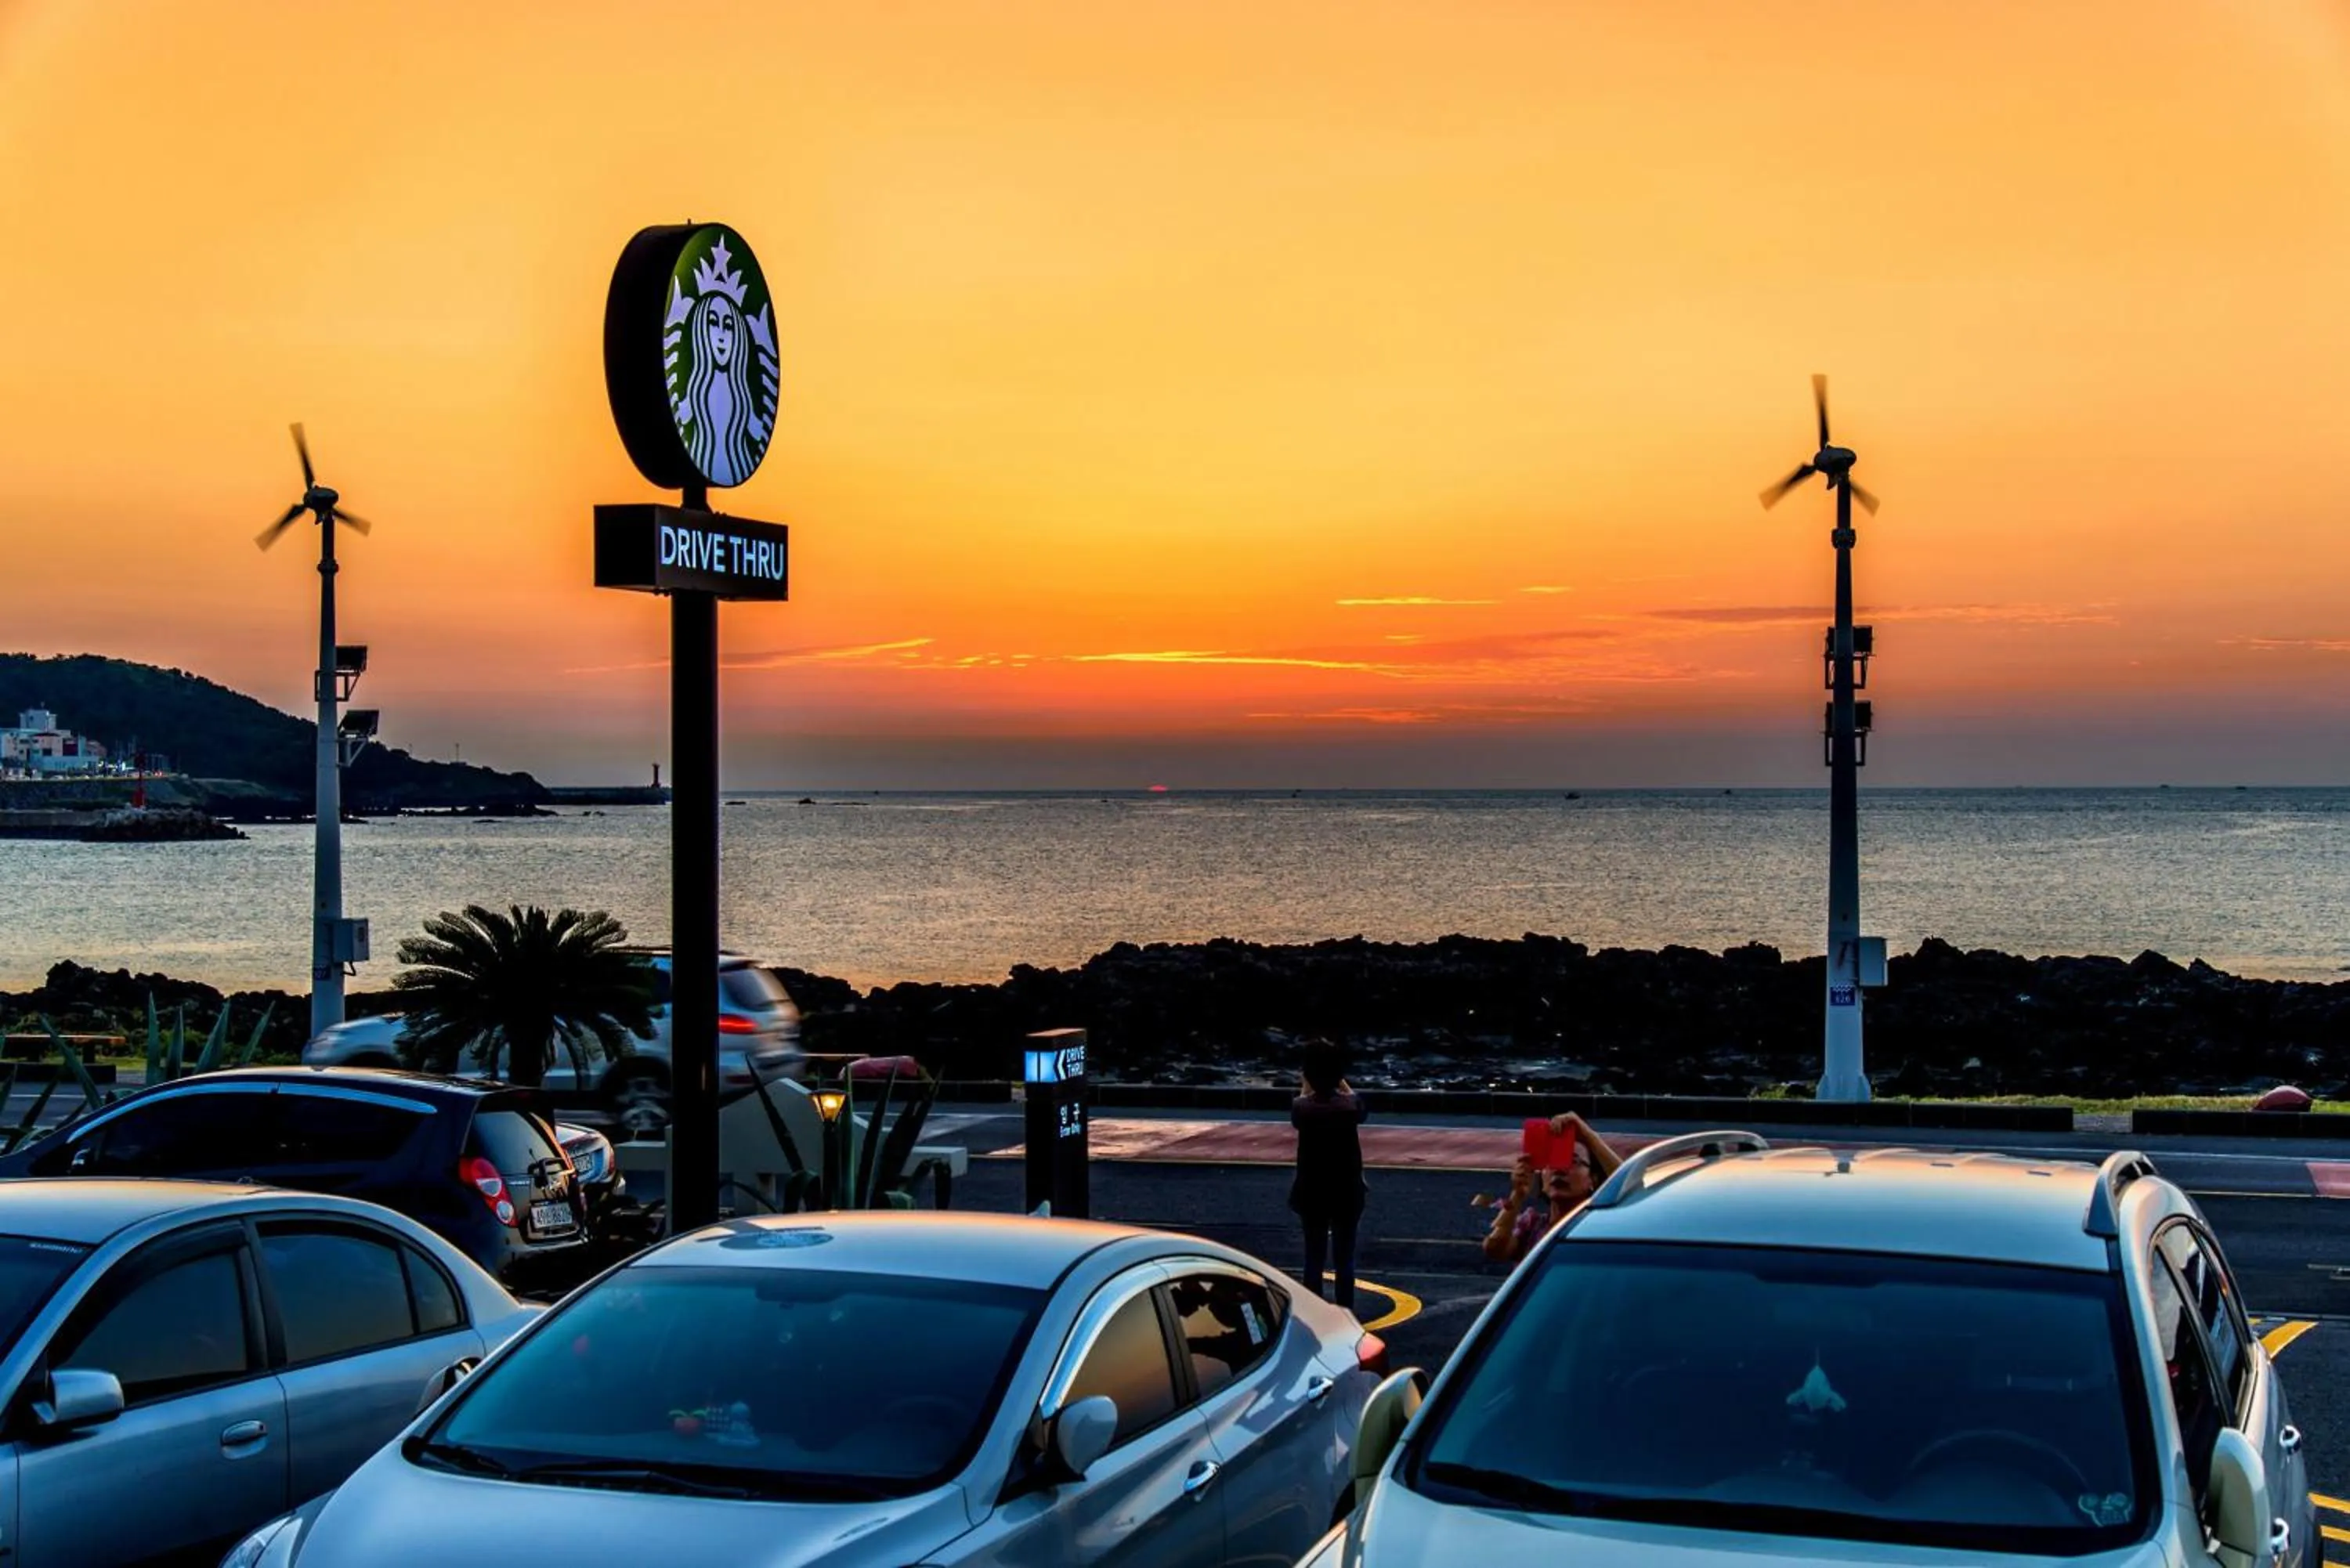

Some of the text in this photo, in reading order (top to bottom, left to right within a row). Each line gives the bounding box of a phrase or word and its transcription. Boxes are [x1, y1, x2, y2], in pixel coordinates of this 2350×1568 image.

[660, 526, 783, 580] DRIVE THRU
[1066, 1046, 1085, 1063] DRIVE
[1066, 1061, 1084, 1078] THRU
